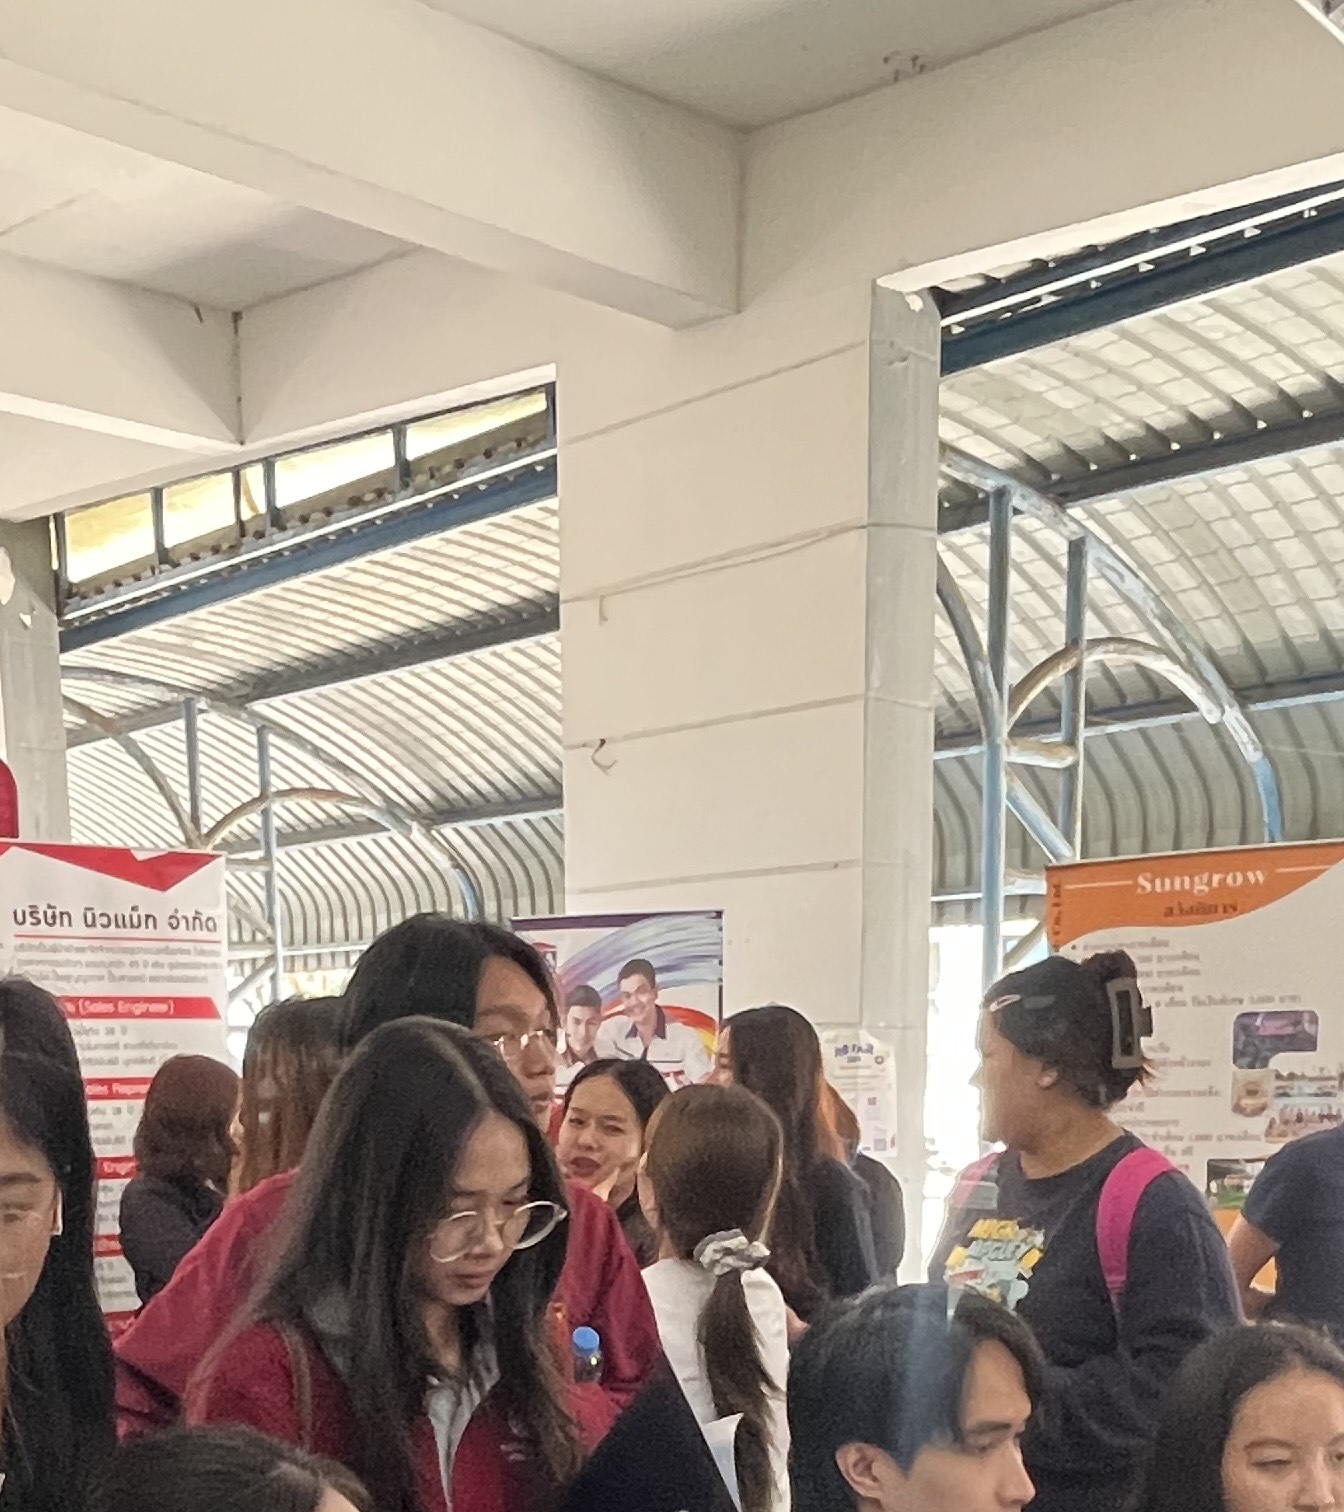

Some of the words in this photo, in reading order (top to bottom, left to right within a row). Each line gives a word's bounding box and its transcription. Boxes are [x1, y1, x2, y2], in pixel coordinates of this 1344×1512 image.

[1136, 870, 1268, 895] Sungrow
[13, 903, 73, 928] บริษัท
[83, 904, 158, 930] นิวแม็ก
[168, 907, 218, 933] จำกัด
